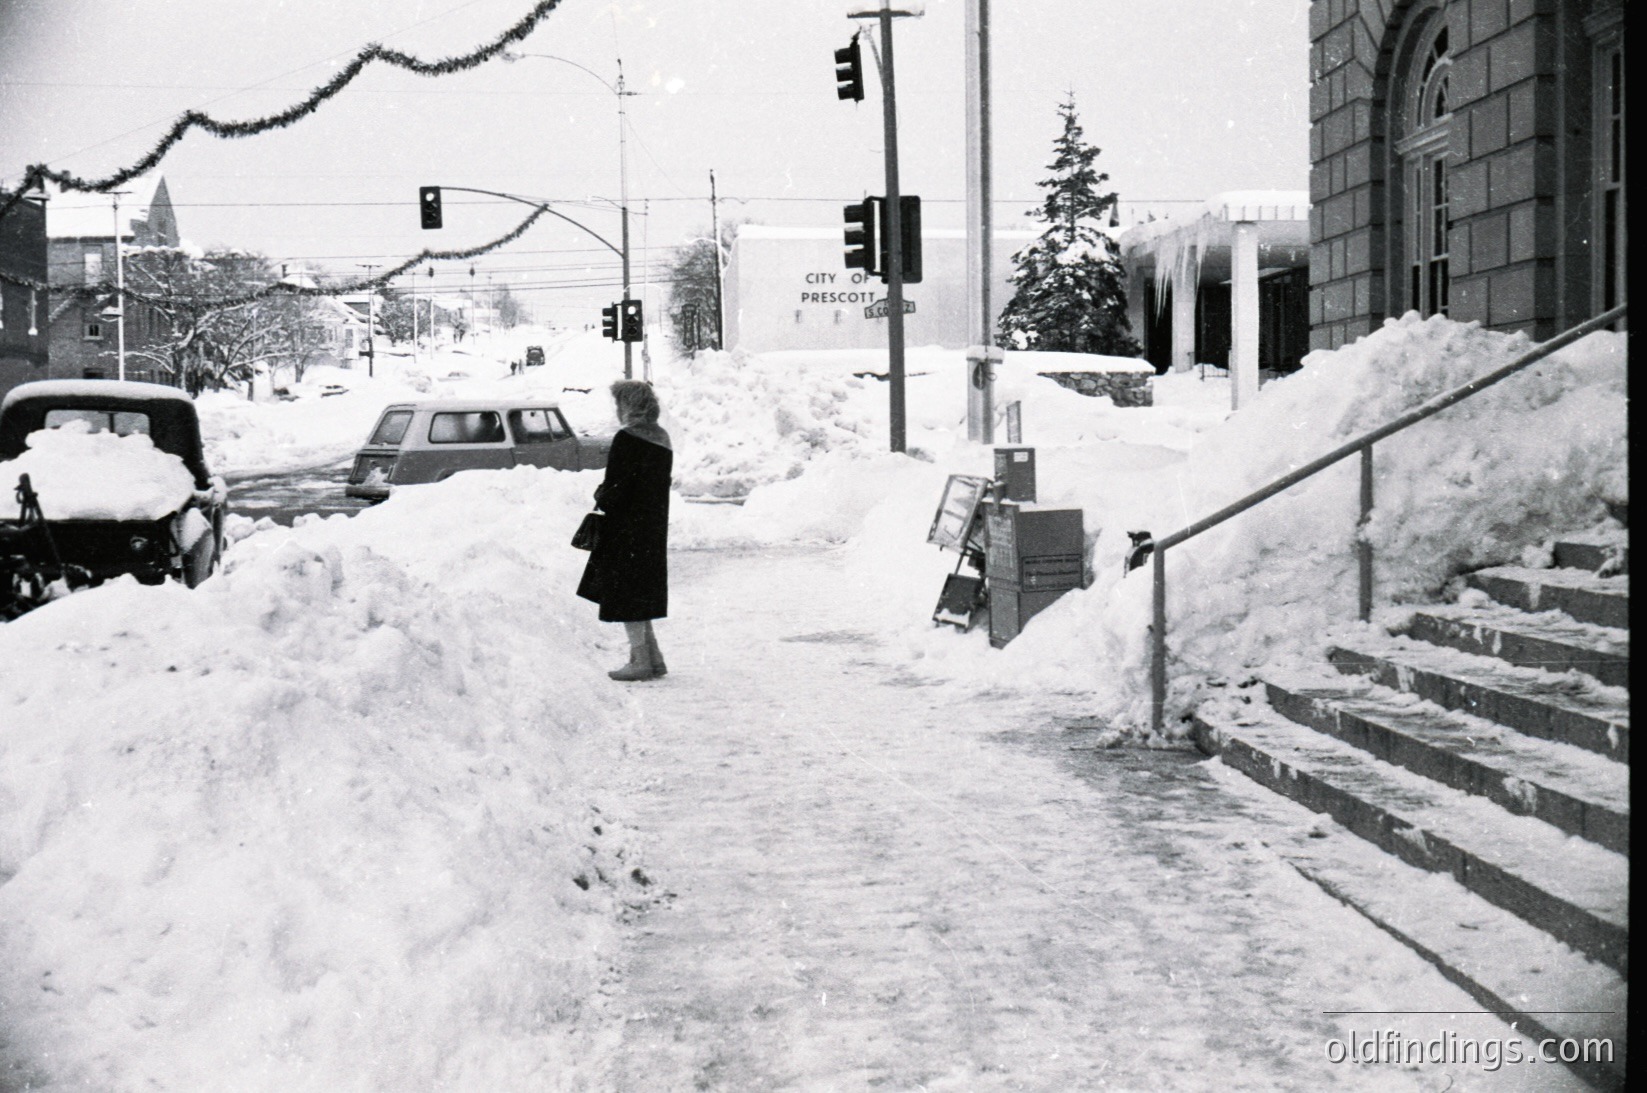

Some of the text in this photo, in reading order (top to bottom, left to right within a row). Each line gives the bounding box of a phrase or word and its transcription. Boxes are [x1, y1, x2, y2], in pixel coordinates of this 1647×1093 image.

[805, 273, 836, 284] CITY
[801, 292, 875, 303] PRESCOTT
[877, 303, 911, 317] COZ
